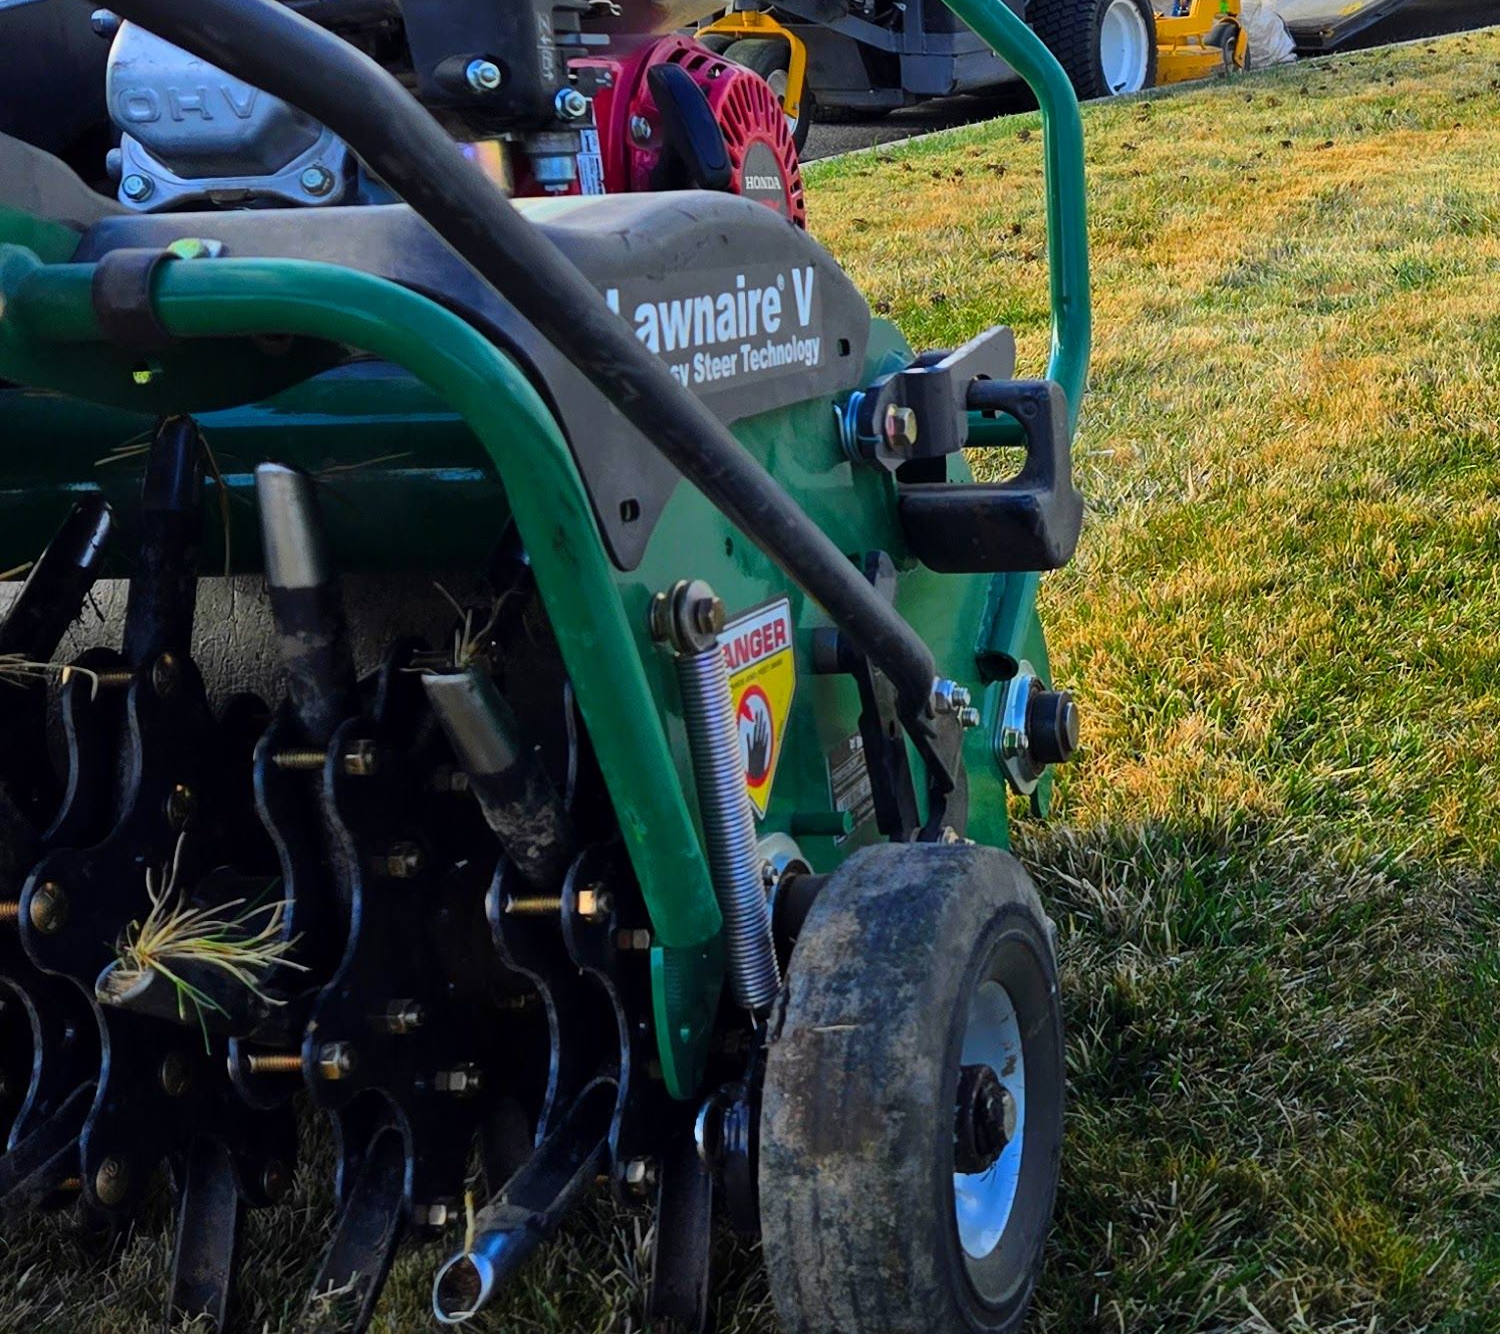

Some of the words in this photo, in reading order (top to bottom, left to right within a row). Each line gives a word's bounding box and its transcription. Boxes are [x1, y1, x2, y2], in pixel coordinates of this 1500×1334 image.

[118, 85, 260, 123] OHV
[745, 175, 782, 190] HONDA
[792, 266, 814, 327] V
[693, 352, 738, 383] Steer
[740, 335, 821, 373] Technology
